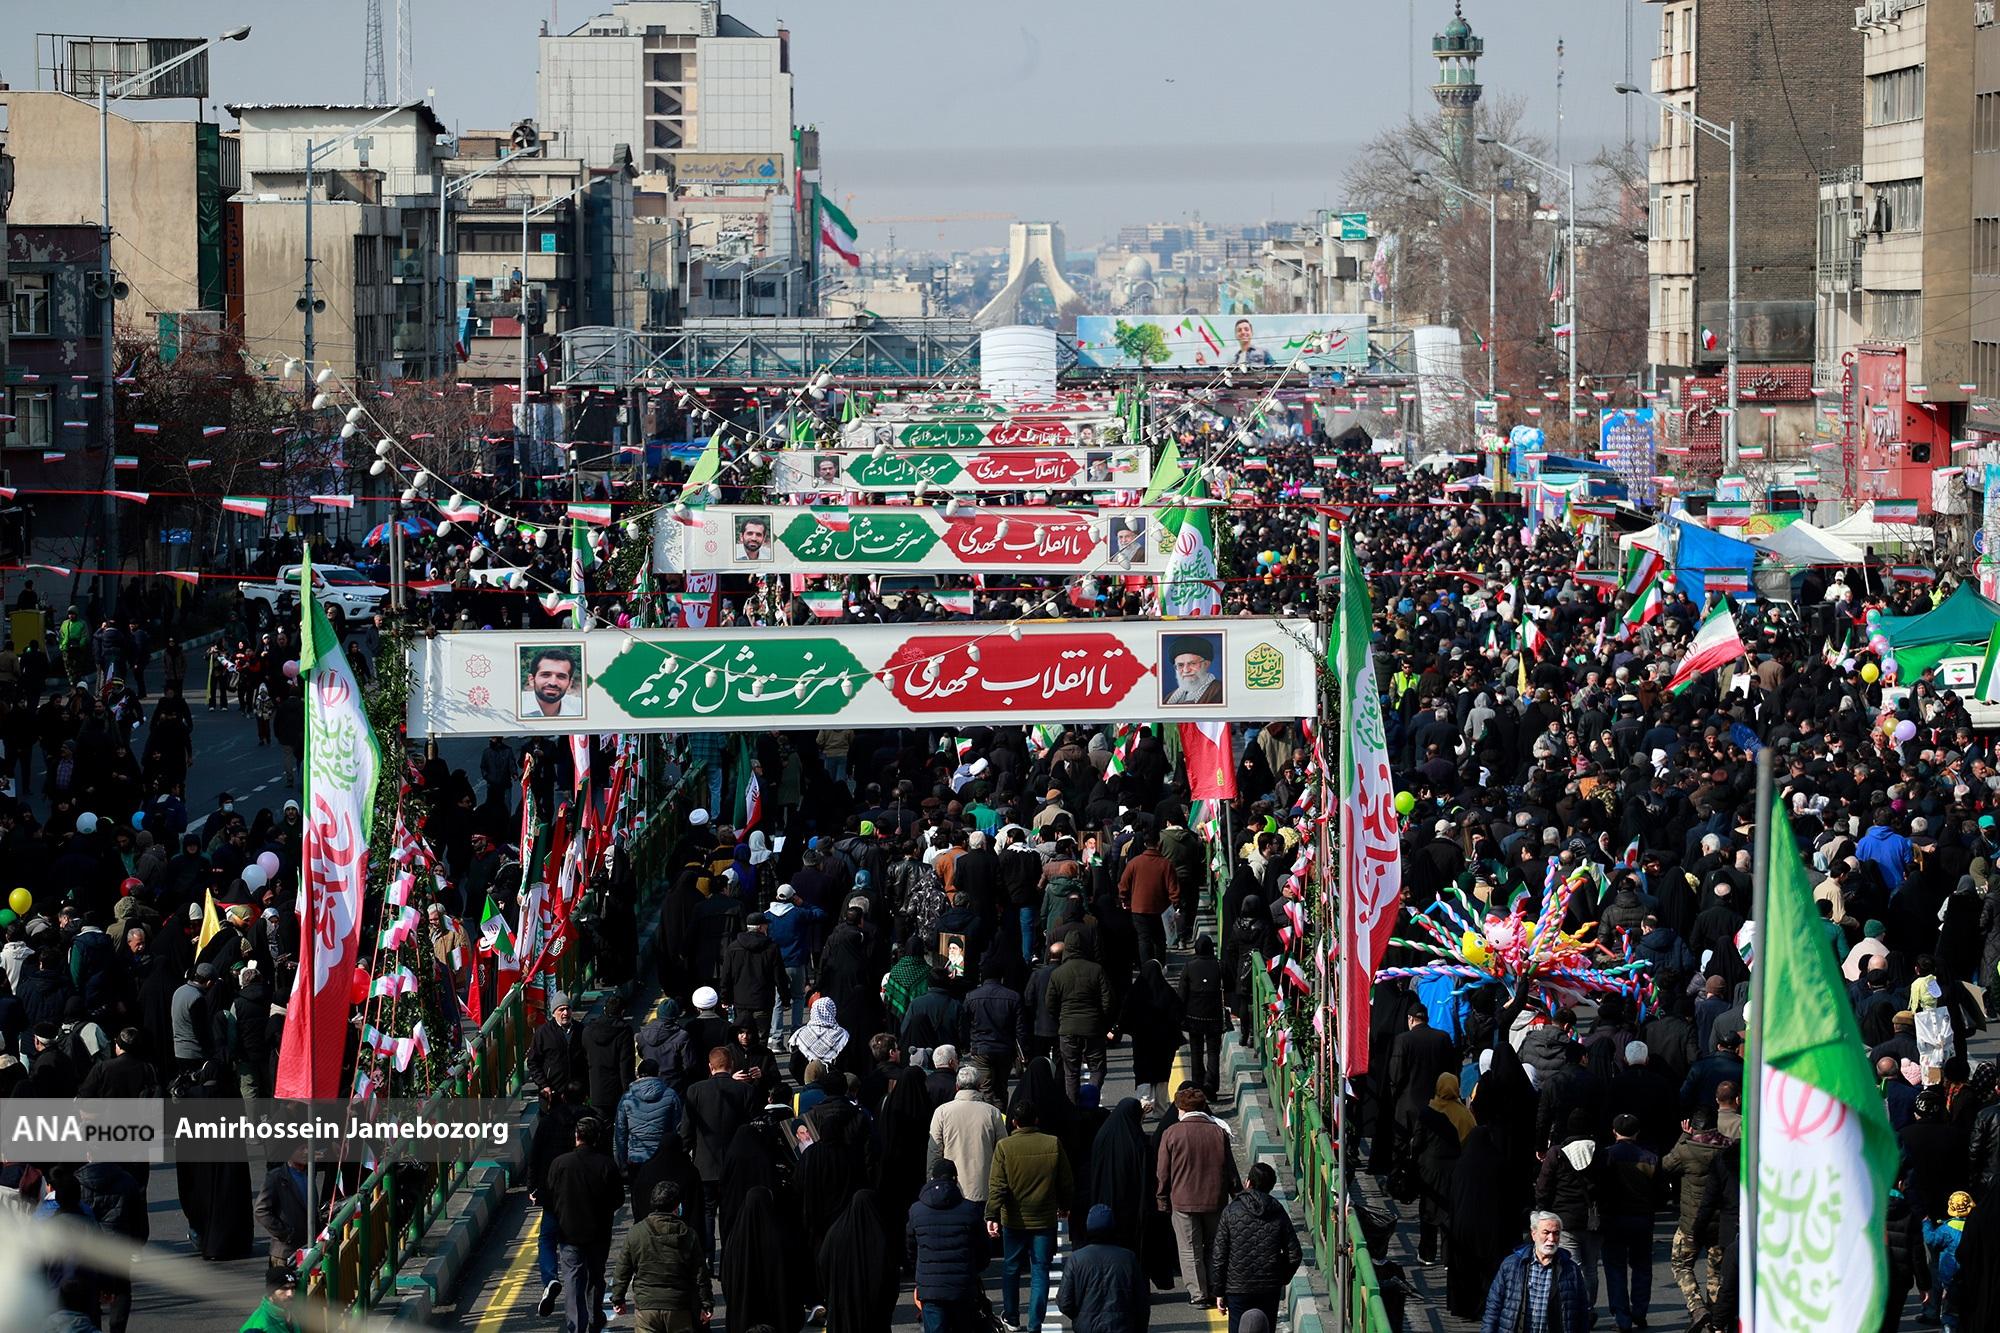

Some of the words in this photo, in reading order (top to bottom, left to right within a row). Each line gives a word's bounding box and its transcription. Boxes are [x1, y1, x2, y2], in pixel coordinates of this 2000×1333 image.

[1842, 352, 1855, 498] CAFETERIA
[977, 460, 1010, 479] مهدی
[1060, 458, 1071, 478] تا
[835, 517, 874, 561] مثل
[861, 522, 927, 560] سرسخت
[1004, 526, 1071, 561] انقلاب
[1071, 526, 1088, 555] تا
[692, 645, 758, 714] مثل
[738, 650, 849, 710] سرسخت
[903, 656, 979, 700] مهدی
[982, 649, 1097, 706] انقلاب
[1098, 649, 1124, 695] تا
